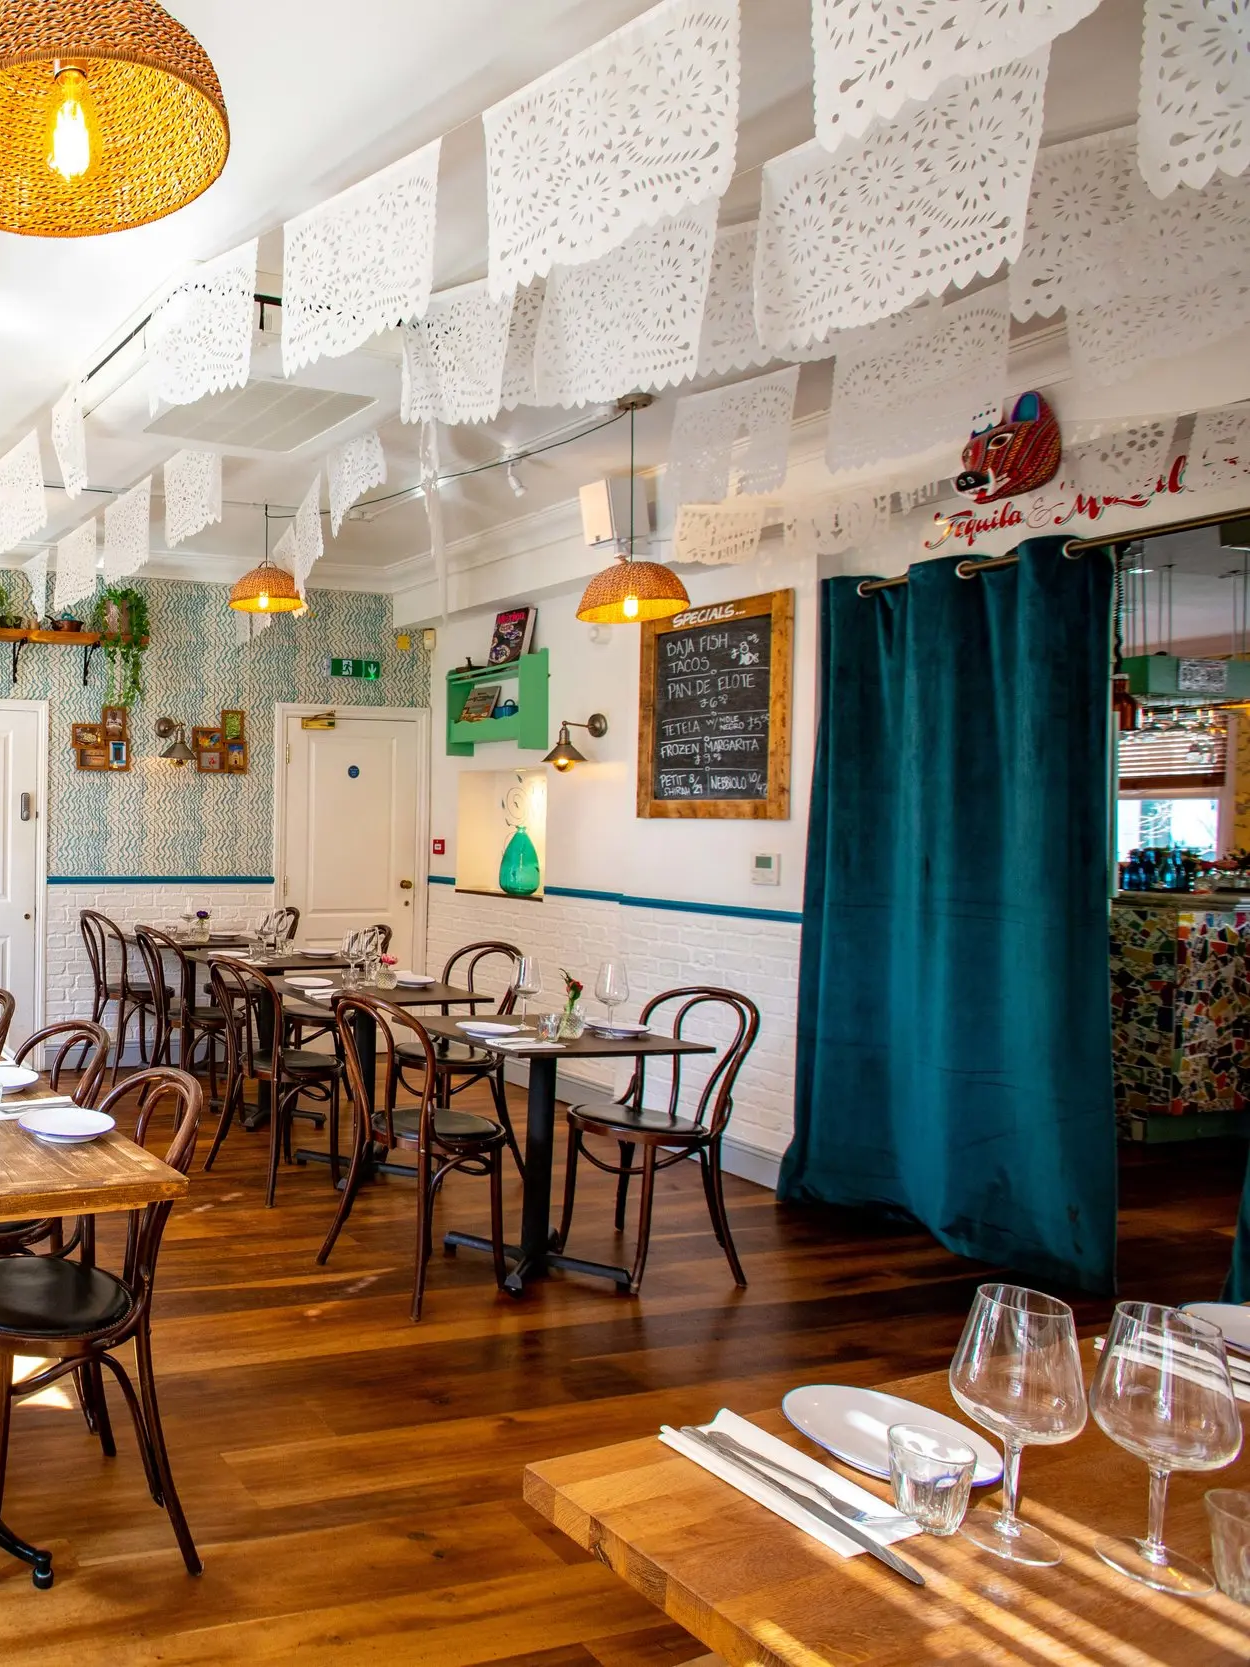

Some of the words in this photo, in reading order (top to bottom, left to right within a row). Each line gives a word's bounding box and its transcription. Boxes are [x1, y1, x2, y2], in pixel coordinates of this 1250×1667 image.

[924, 501, 1025, 549] Tequila
[666, 637, 695, 659] BAJA
[699, 633, 728, 652] FISH
[668, 656, 710, 674] TACOS
[668, 682, 691, 700] PAN
[696, 679, 710, 695] DE
[717, 673, 756, 691] ELOTE
[661, 720, 701, 736] TETELA
[719, 721, 745, 731] NEGRO
[660, 743, 700, 759] FROZEN
[704, 738, 760, 752] MARGARITA
[659, 773, 687, 788] PETIT
[710, 774, 747, 791] NEBBIOLO
